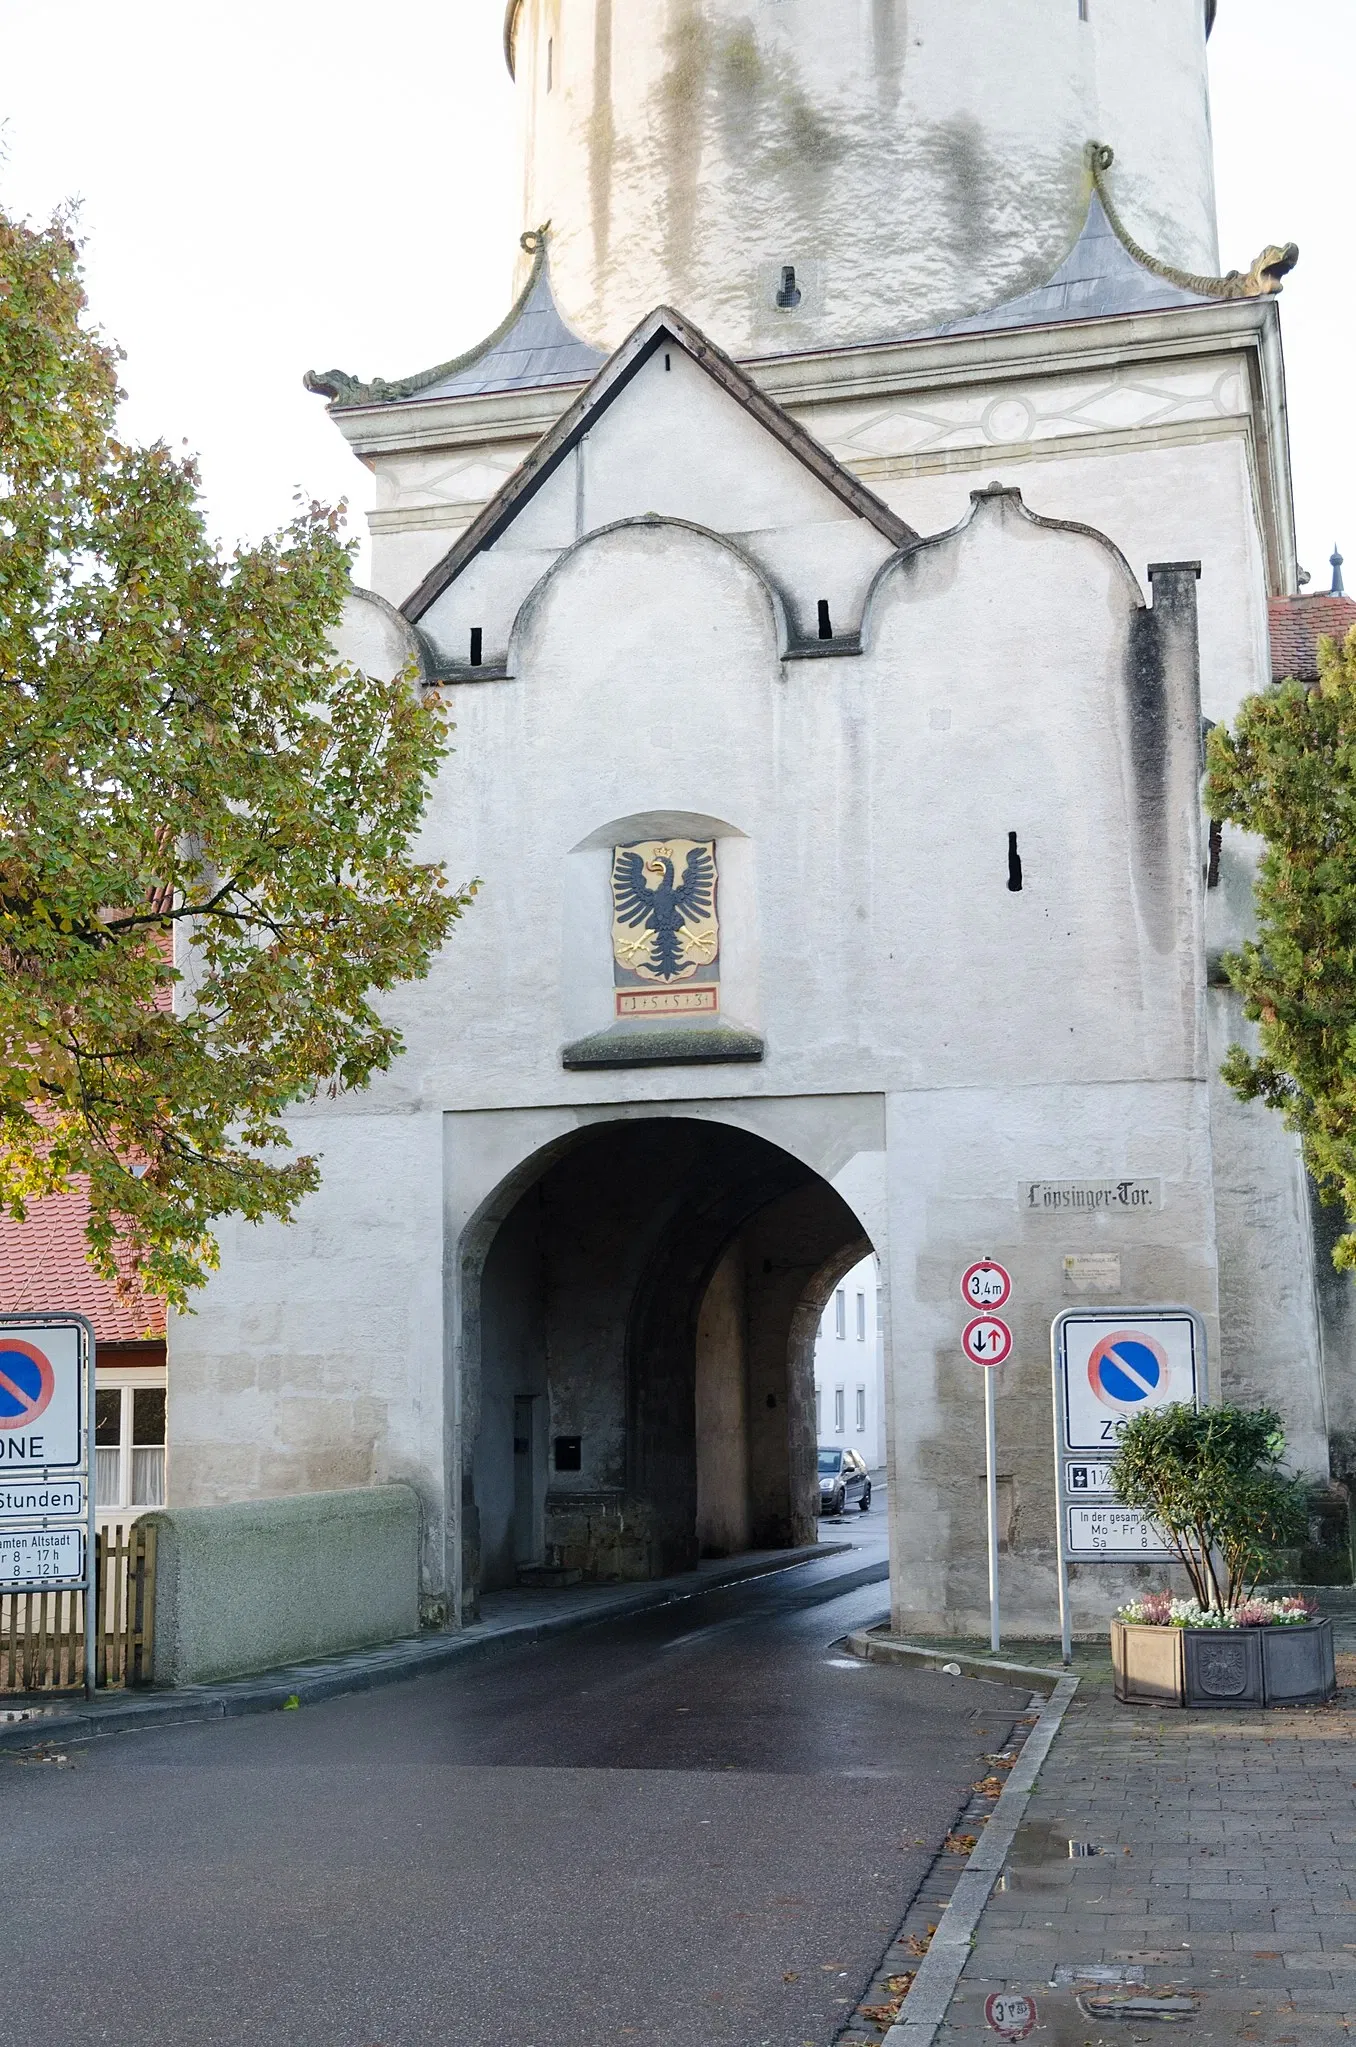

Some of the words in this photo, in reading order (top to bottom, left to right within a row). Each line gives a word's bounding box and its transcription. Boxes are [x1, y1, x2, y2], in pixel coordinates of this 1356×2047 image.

[1080, 1511, 1089, 1522] In
[1091, 1511, 1107, 1522] der
[1091, 1525, 1108, 1535] Mo
[1122, 1524, 1135, 1535] Fr
[1140, 1524, 1148, 1535] 8
[31, 1534, 71, 1548] Altstadt
[1092, 1537, 1107, 1548] Sa
[1141, 1537, 1148, 1548] 8
[13, 1550, 21, 1562] 8
[37, 1549, 50, 1561] 17
[53, 1549, 59, 1560] h
[13, 1565, 21, 1577] 8
[37, 1563, 50, 1575] 12
[53, 1563, 59, 1574] h
